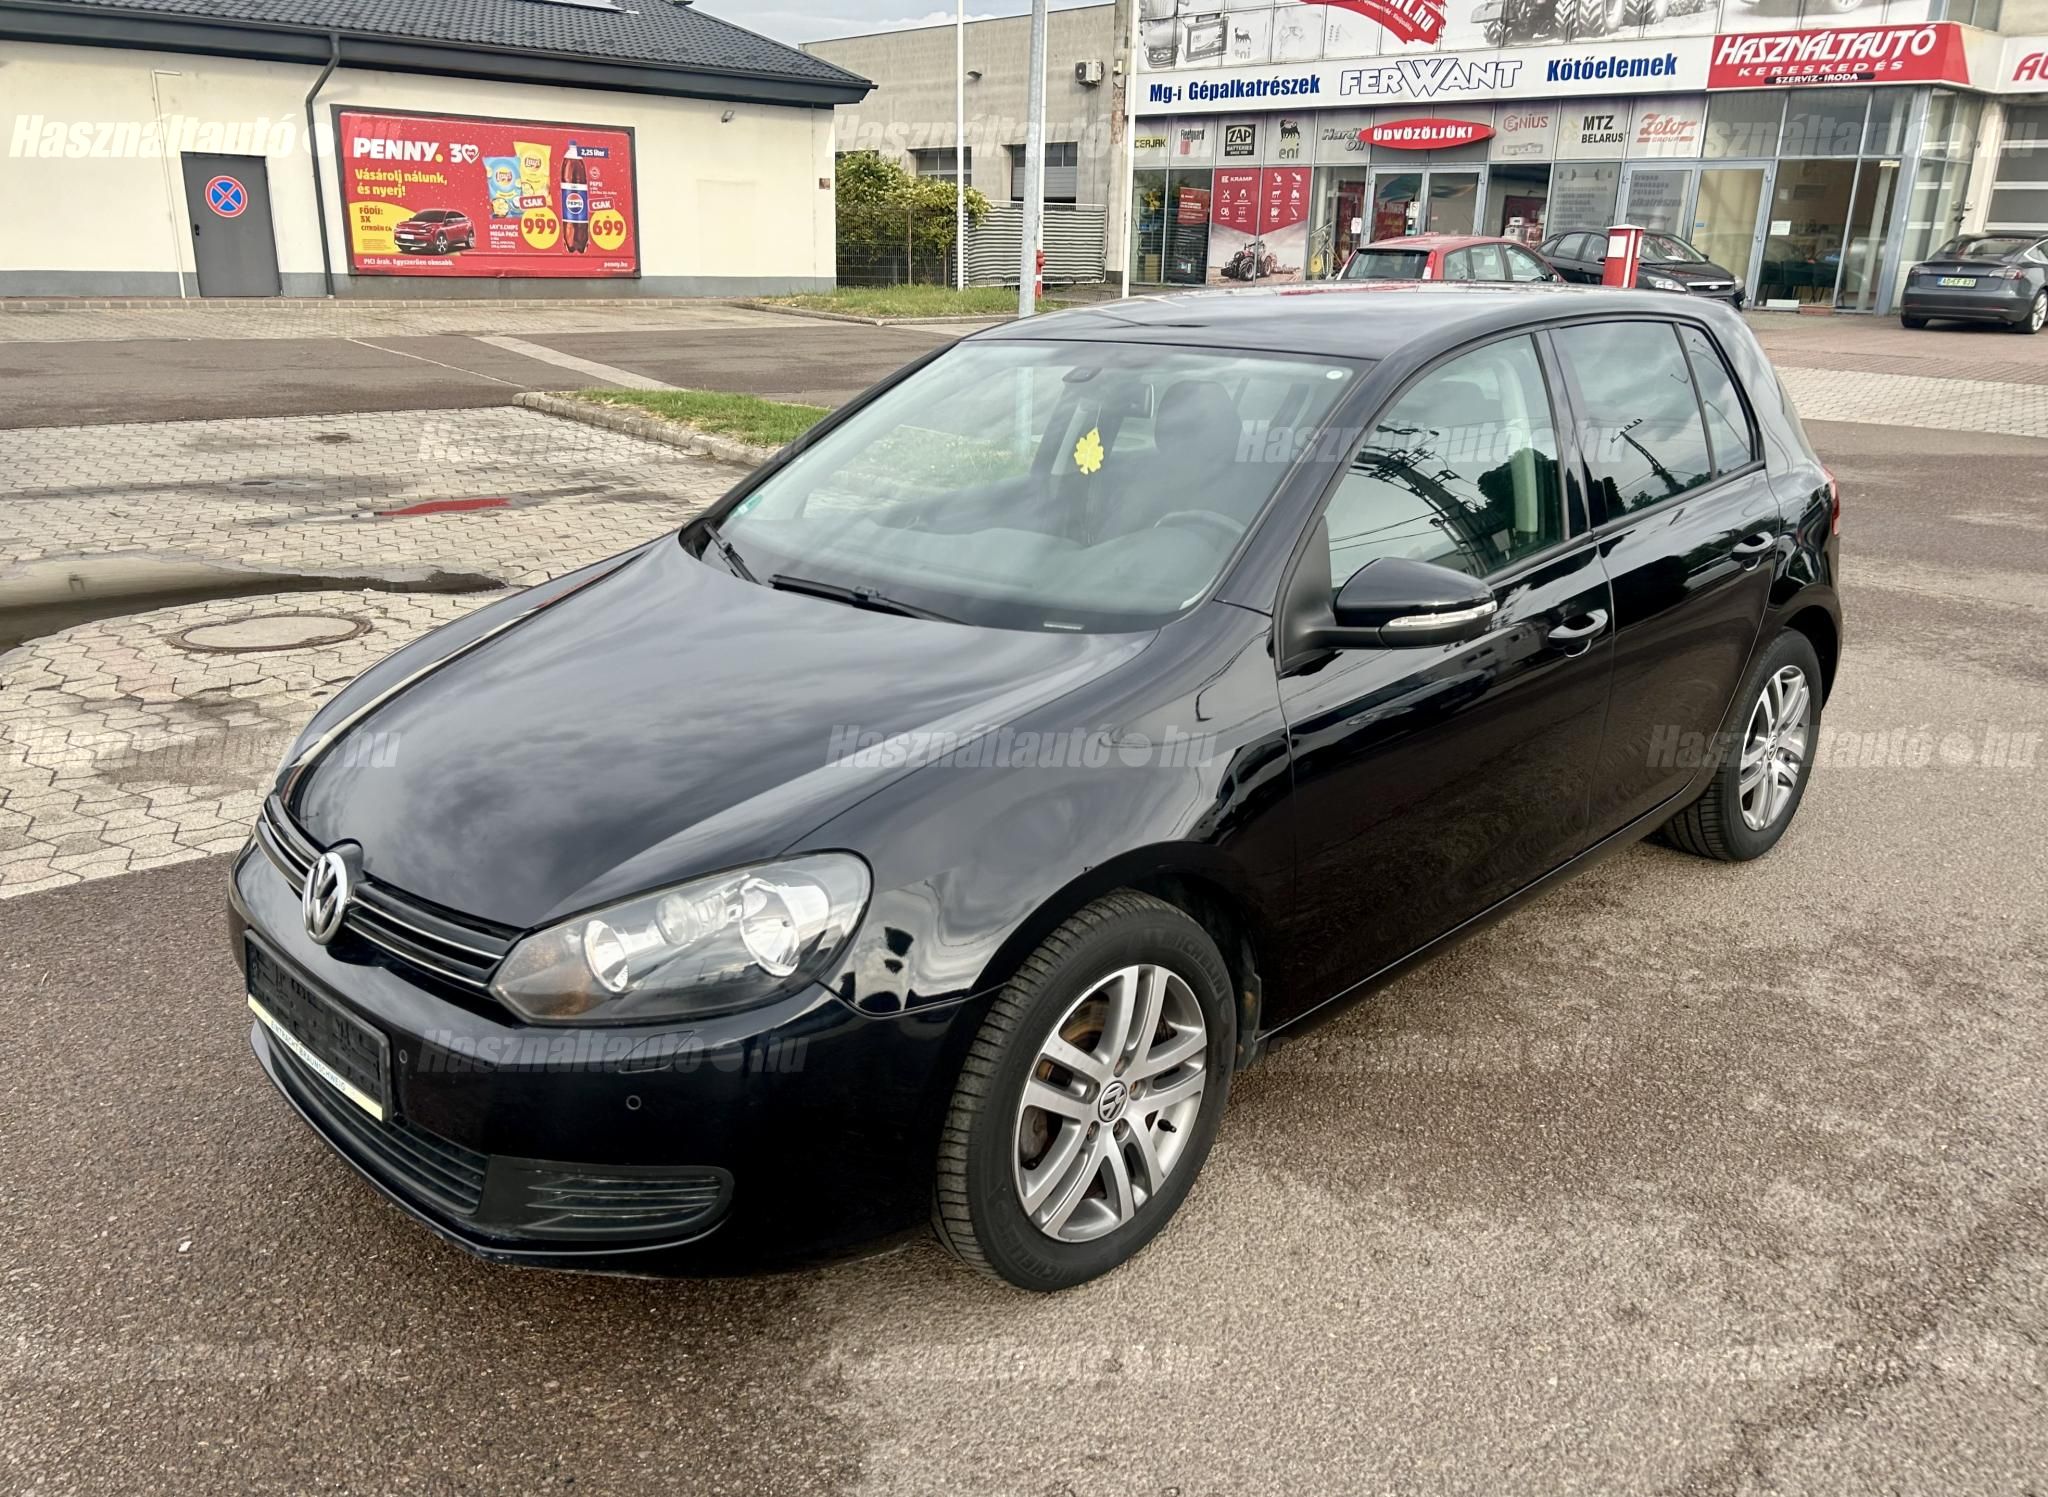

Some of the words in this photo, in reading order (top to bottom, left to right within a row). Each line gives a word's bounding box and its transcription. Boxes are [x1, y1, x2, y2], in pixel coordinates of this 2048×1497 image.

[1715, 25, 1937, 65] HASZNÁLTAUTÓ
[1546, 53, 1678, 82] Kötőelemek
[1738, 60, 1904, 77] KERESKEDÉS
[1149, 83, 1182, 104] Mg-i
[1188, 74, 1321, 102] Gépalkatrészek
[1583, 115, 1615, 131] MTZ
[1639, 113, 1697, 136] Zetor
[1229, 128, 1251, 142] ZAP
[1373, 125, 1473, 141] ÜDVÖZÖLJÜK!
[1581, 133, 1625, 143] BELARUS
[1279, 143, 1300, 159] eni
[355, 168, 403, 183] Vásárolj
[404, 170, 447, 185] nálunk,
[357, 182, 371, 195] és
[372, 185, 406, 198] nyerj!
[523, 198, 544, 207] CSAK
[592, 200, 611, 209] CSAK
[523, 218, 557, 235] 999
[592, 219, 624, 236] 699
